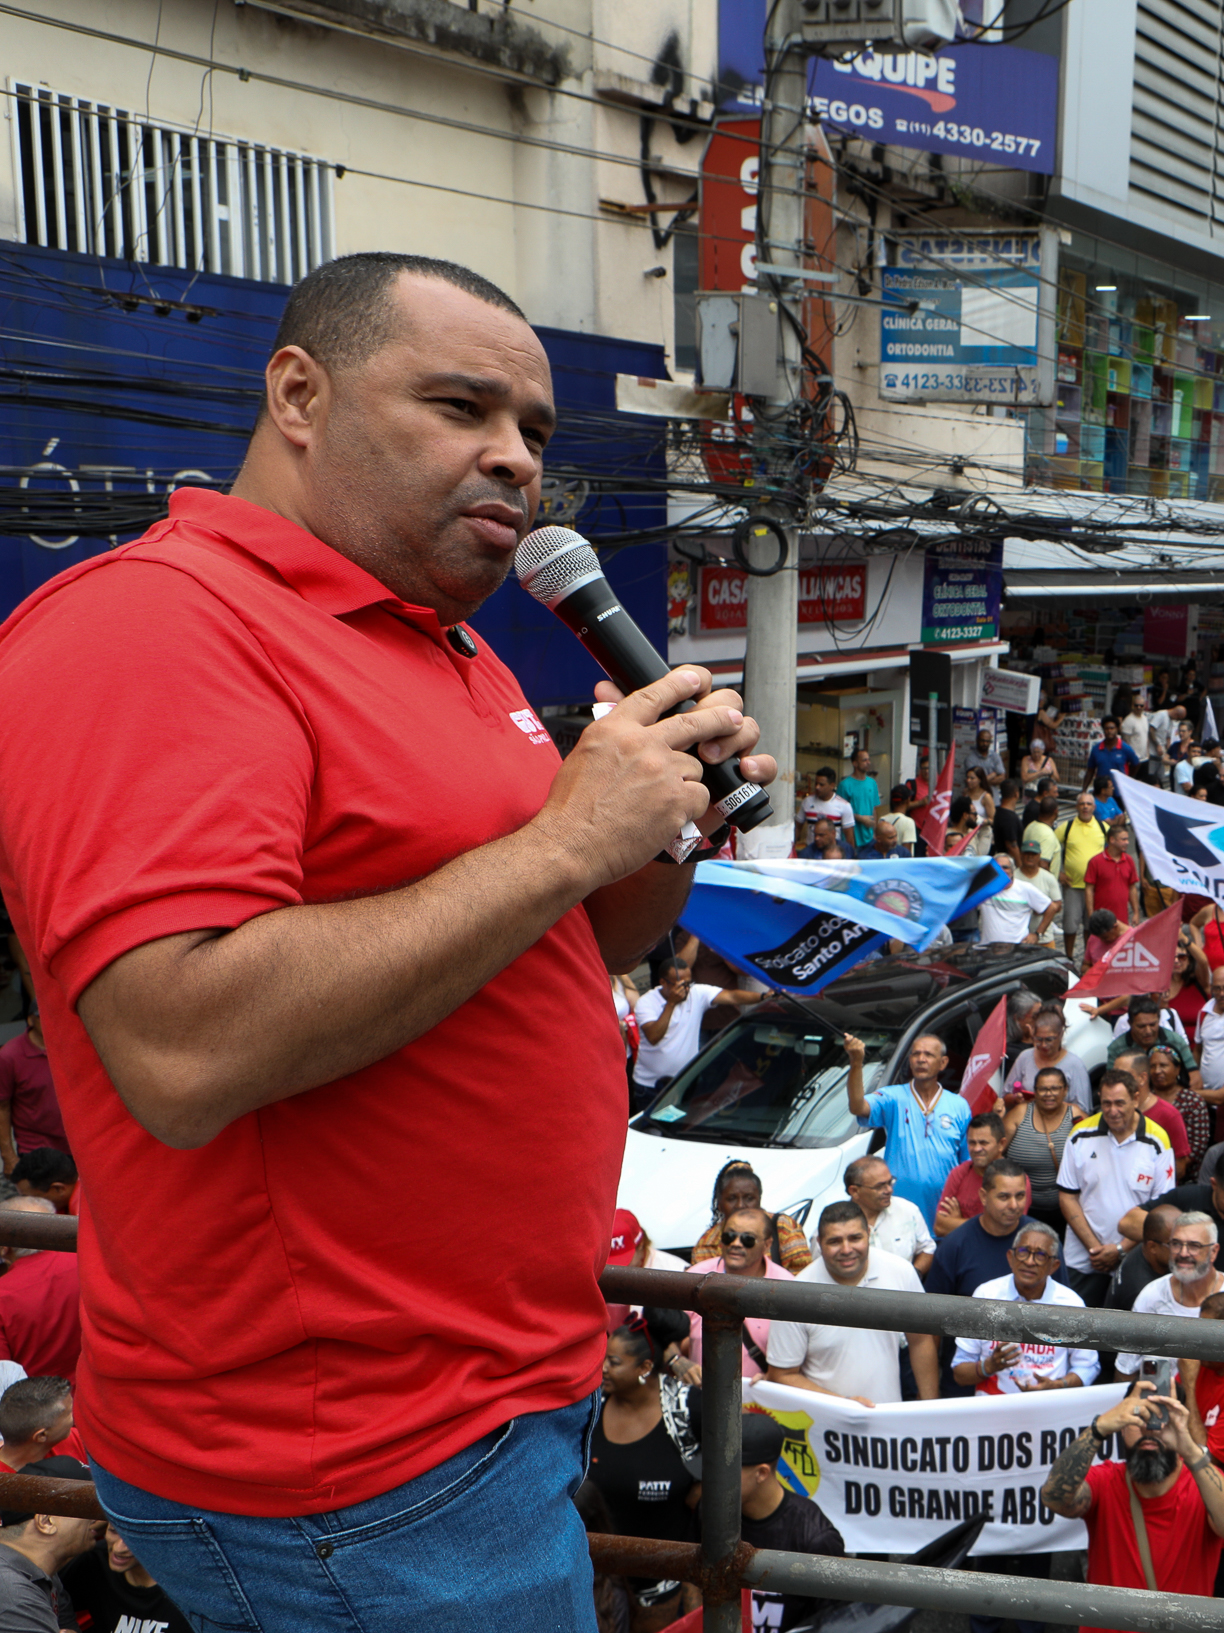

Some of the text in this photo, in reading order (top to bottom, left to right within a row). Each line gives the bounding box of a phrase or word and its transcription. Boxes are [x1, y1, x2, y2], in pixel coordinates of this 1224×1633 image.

[933, 121, 1041, 157] 4330-2577
[883, 314, 959, 332] CLÍNICA GERAL
[887, 343, 954, 357] ORTODONTIA
[901, 373, 963, 390] 4123-33
[708, 575, 862, 605] CASA LIANÇAS
[933, 582, 988, 600] CLÍNICA GERAL
[596, 604, 623, 622] SHURE
[933, 602, 987, 618] ORTODONTIA
[940, 626, 983, 638] 4123-3327
[724, 781, 758, 810] 5061611
[819, 914, 849, 938] dos
[792, 938, 842, 981] Santo
[1136, 1173, 1153, 1185] PT
[989, 1340, 1055, 1355] JNADA
[824, 1430, 969, 1473] SINDICATO
[978, 1431, 1032, 1472] DOS
[639, 1480, 671, 1491] PATTY
[845, 1480, 881, 1516] DO
[889, 1482, 994, 1522] GRANDE
[113, 1614, 169, 1633] NIKE
